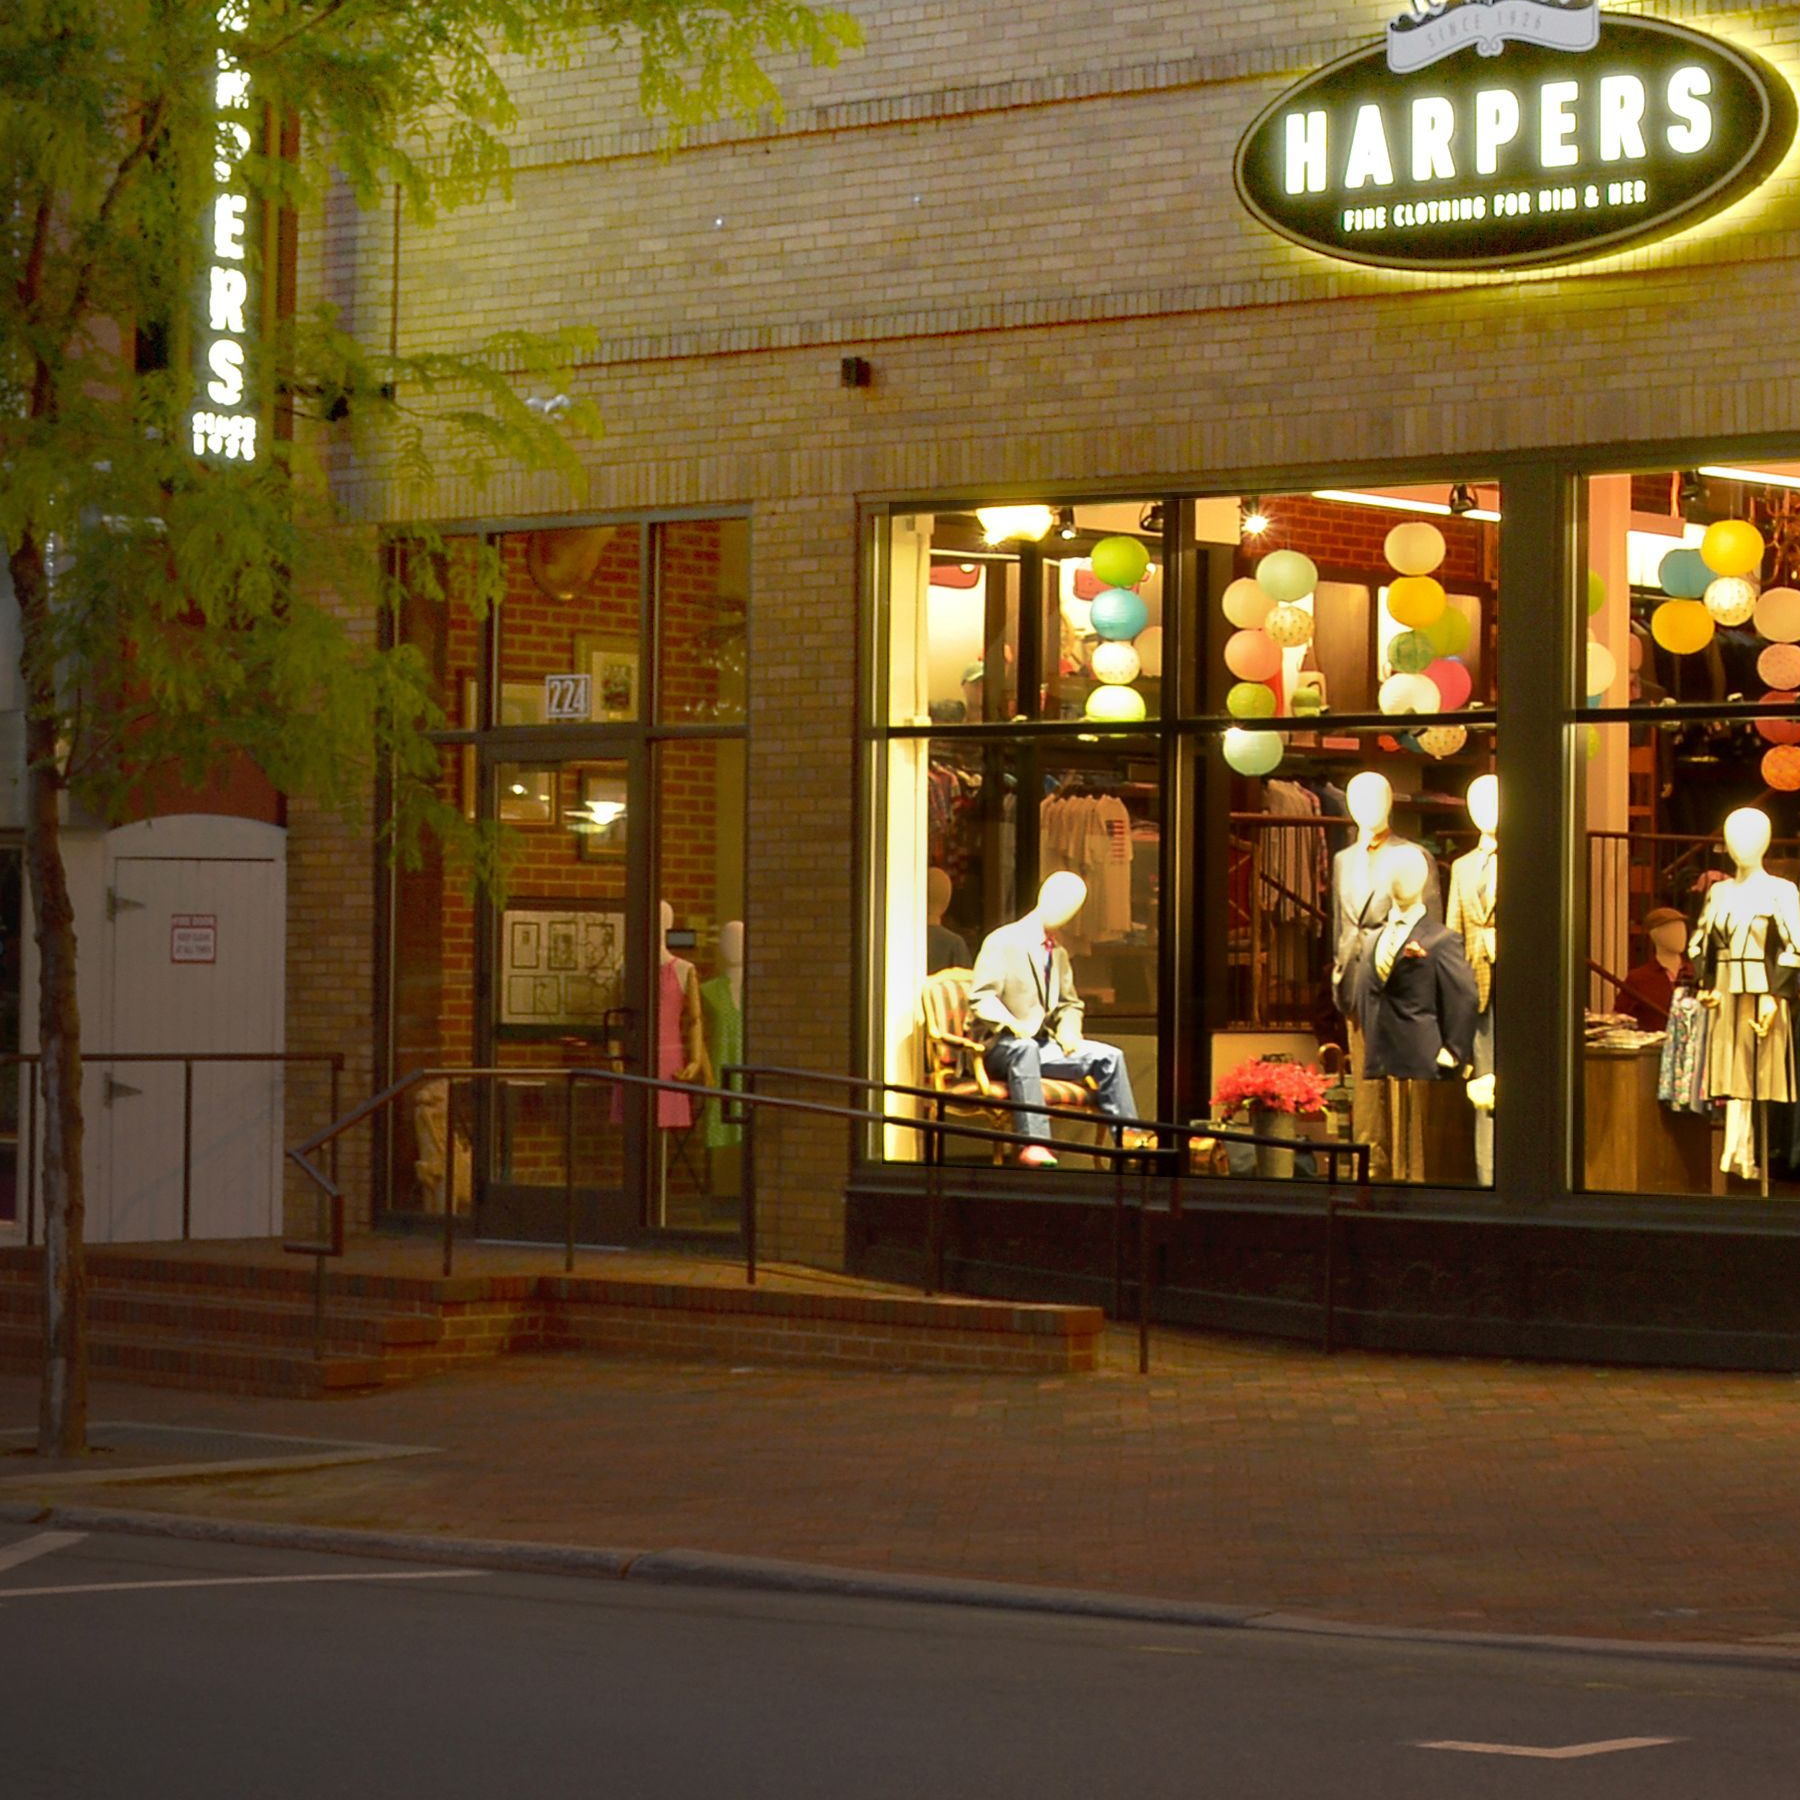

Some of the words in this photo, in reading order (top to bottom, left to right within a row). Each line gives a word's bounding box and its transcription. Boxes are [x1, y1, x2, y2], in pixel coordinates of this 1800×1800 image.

[1427, 13, 1481, 48] SINCE
[1497, 10, 1542, 32] 1926
[1284, 65, 1713, 195] HARPERS
[1343, 206, 1387, 232] FINE
[1393, 196, 1487, 227] CLOTHING
[1494, 192, 1531, 217] FOR
[1539, 187, 1577, 212] HIM
[1584, 185, 1600, 209] &
[1608, 180, 1647, 206] HER
[550, 679, 586, 713] 224
